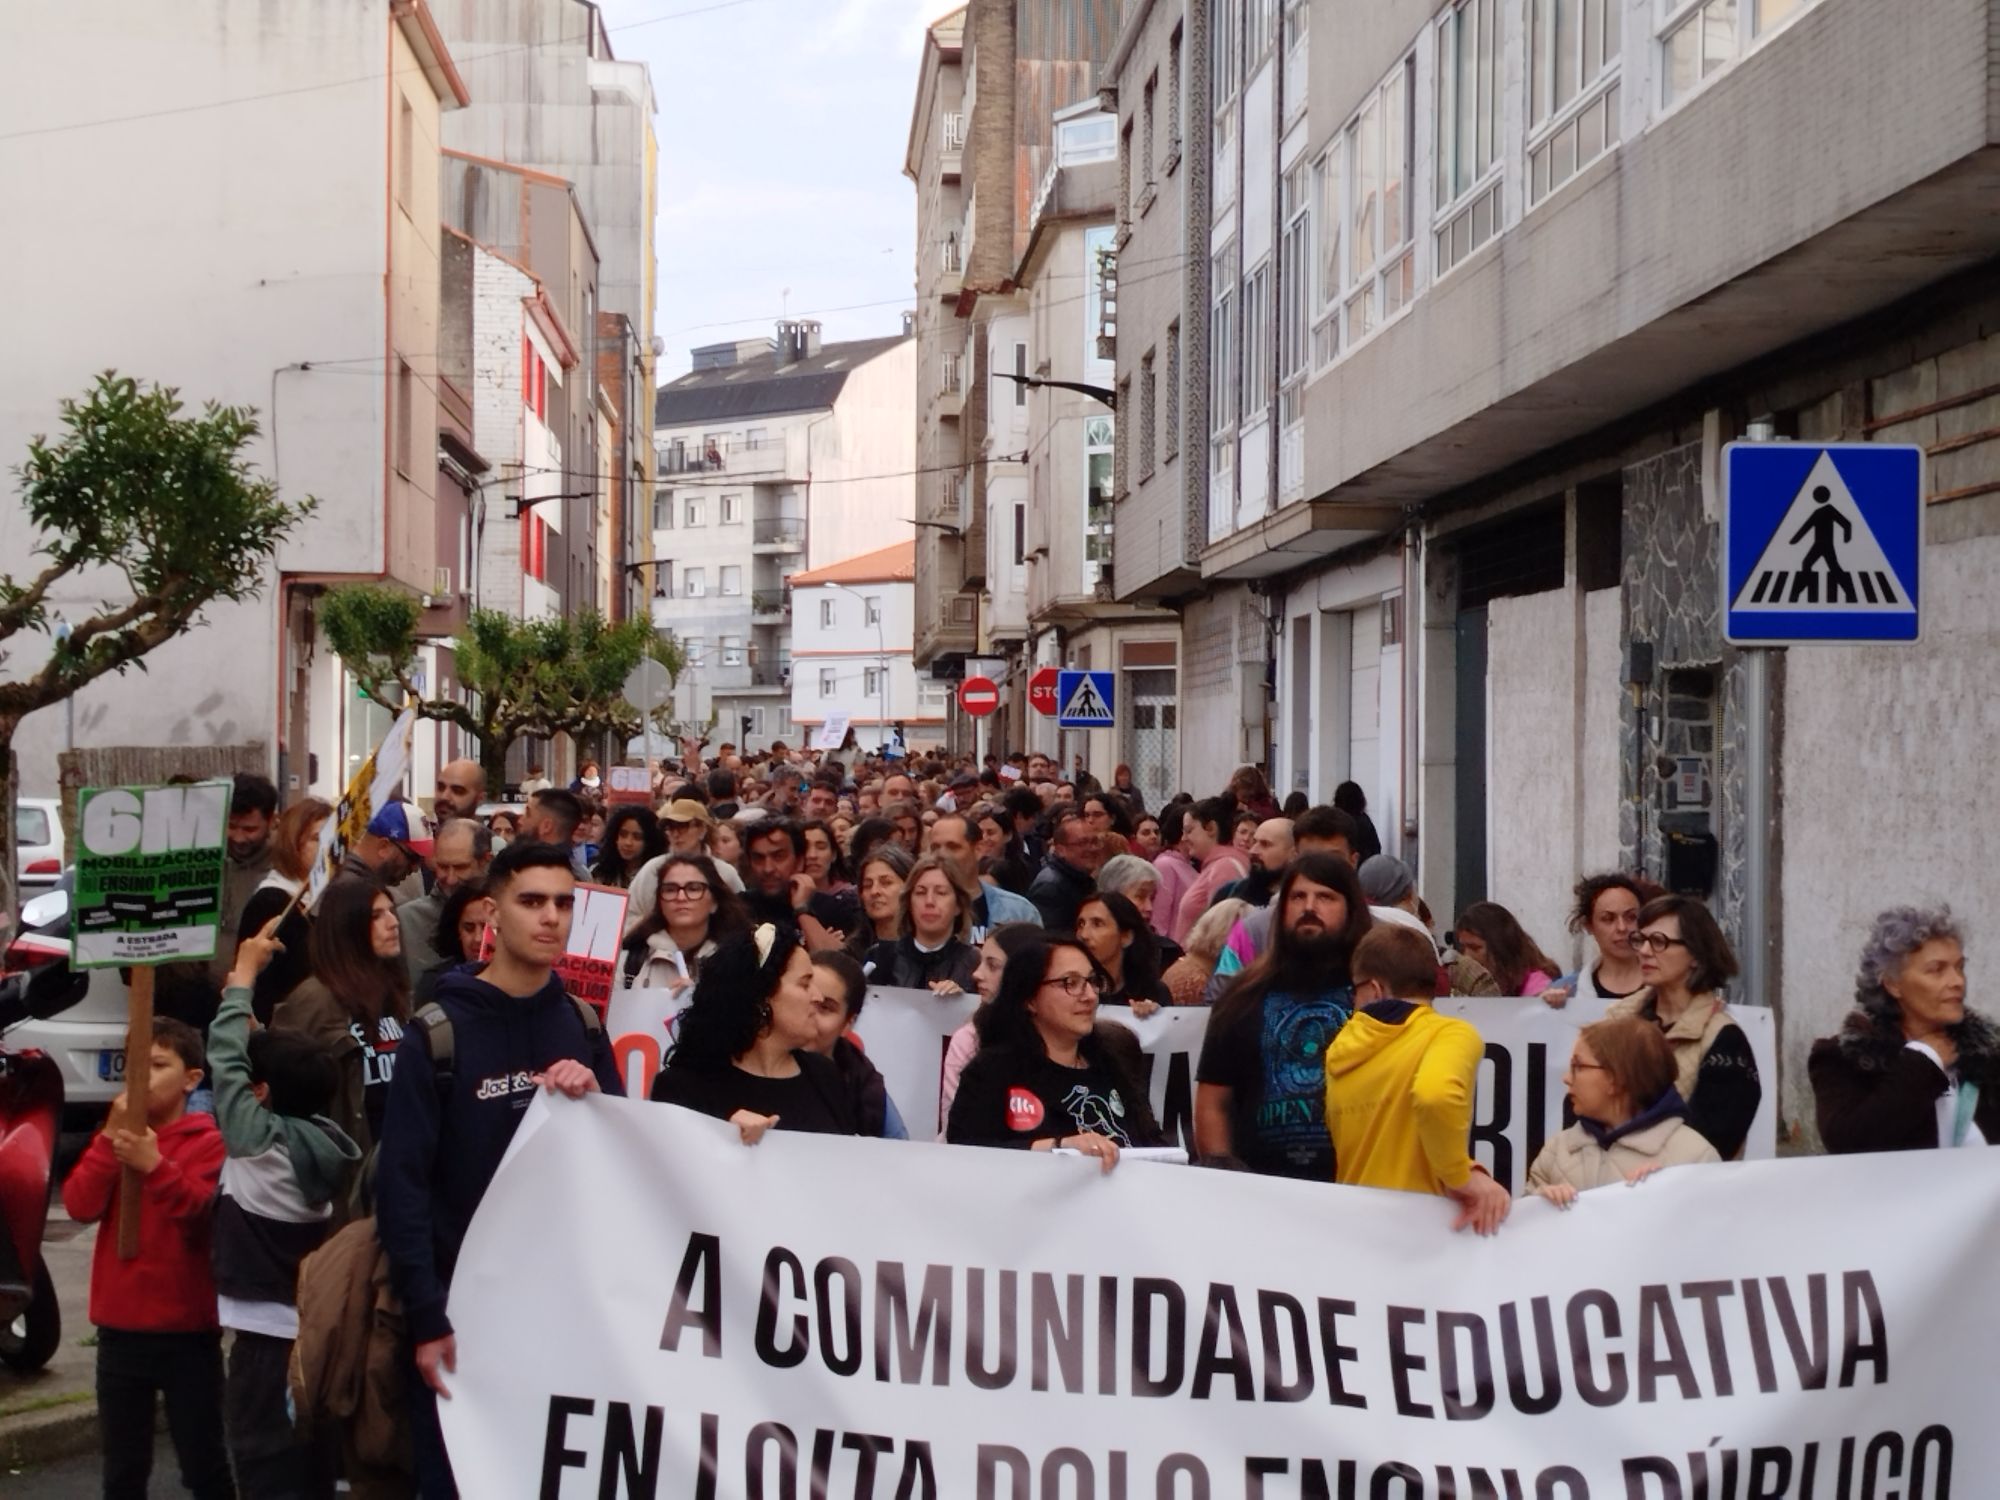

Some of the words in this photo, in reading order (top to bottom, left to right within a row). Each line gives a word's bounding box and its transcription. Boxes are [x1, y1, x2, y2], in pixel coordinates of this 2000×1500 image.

[83, 786, 227, 855] 6M
[100, 874, 156, 892] ENSINO
[566, 886, 627, 962] M
[659, 1231, 724, 1359] A
[753, 1245, 1368, 1411] COMUNIDADE
[1386, 1269, 1893, 1422] EDUCATIVA
